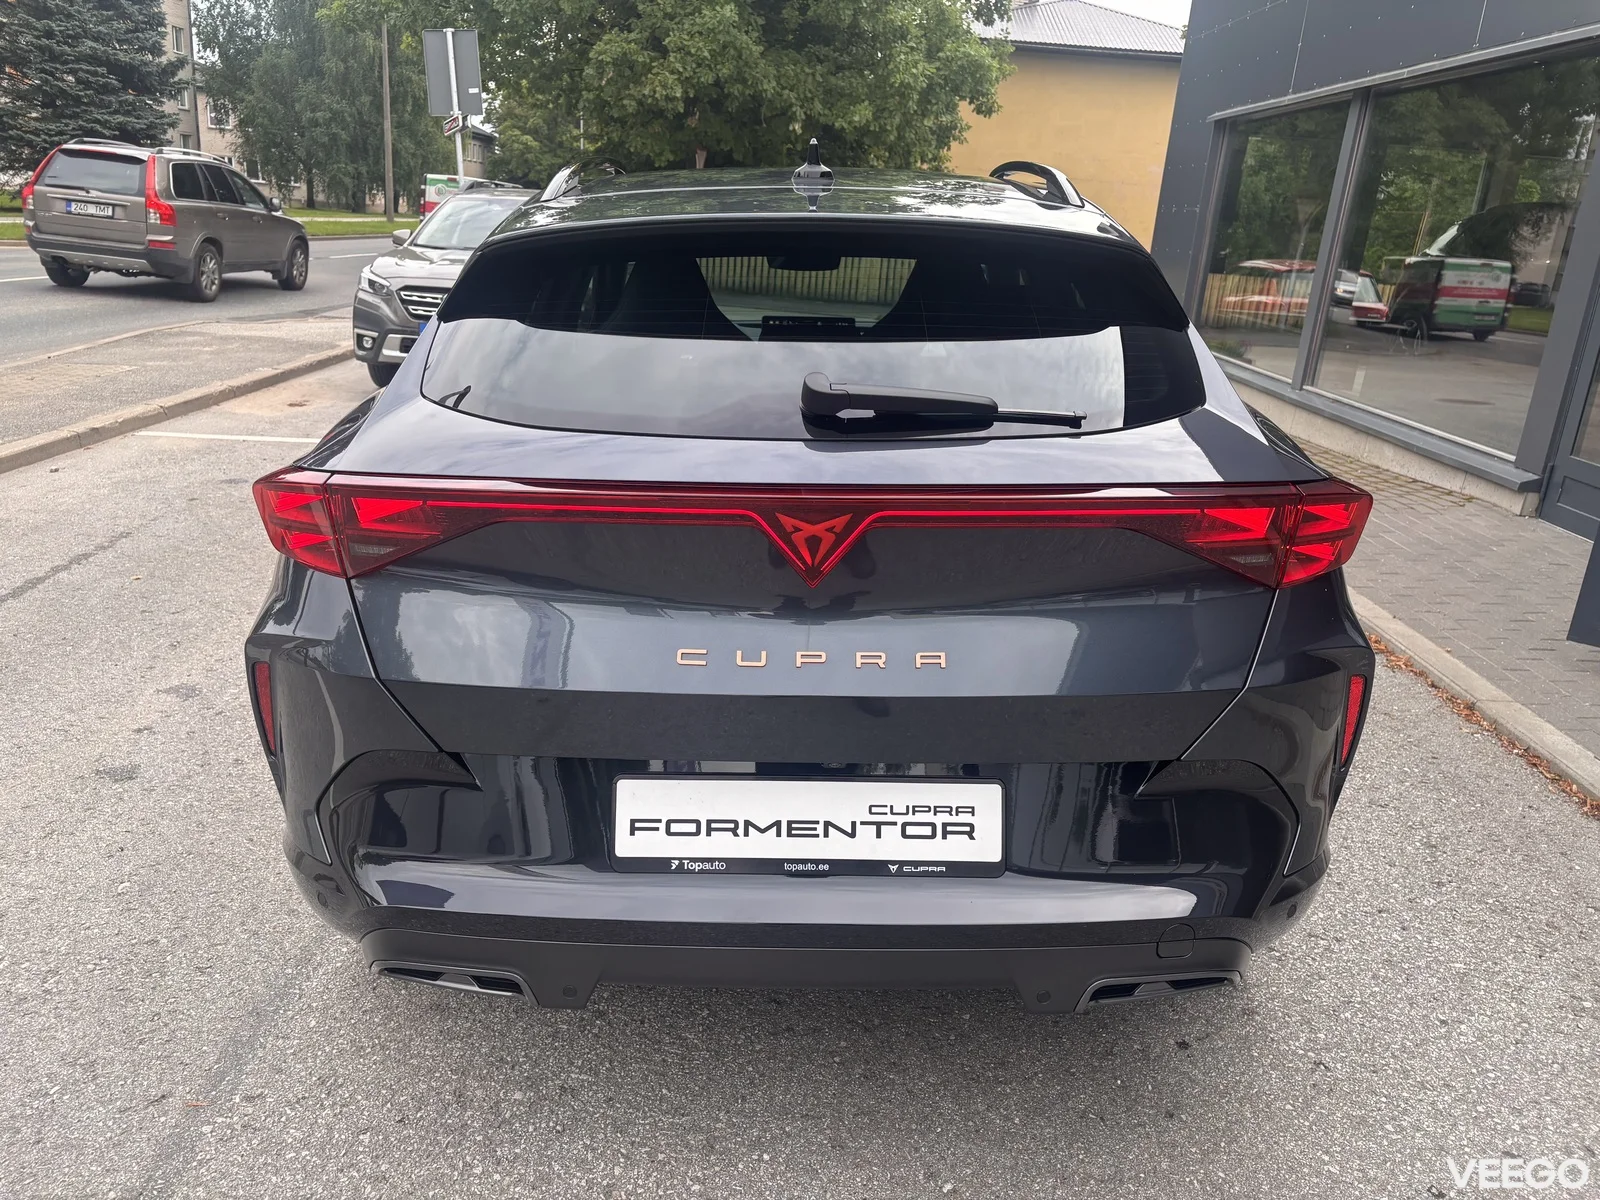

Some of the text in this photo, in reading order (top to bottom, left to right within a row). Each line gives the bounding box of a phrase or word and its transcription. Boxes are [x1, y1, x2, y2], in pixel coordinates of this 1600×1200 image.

[74, 203, 110, 214] 240 TMT
[676, 648, 947, 669] CUPRA
[868, 804, 975, 817] CUPRA
[629, 818, 976, 841] FORMENTOR
[682, 859, 726, 872] Topauto
[784, 861, 829, 873] topauto.ee
